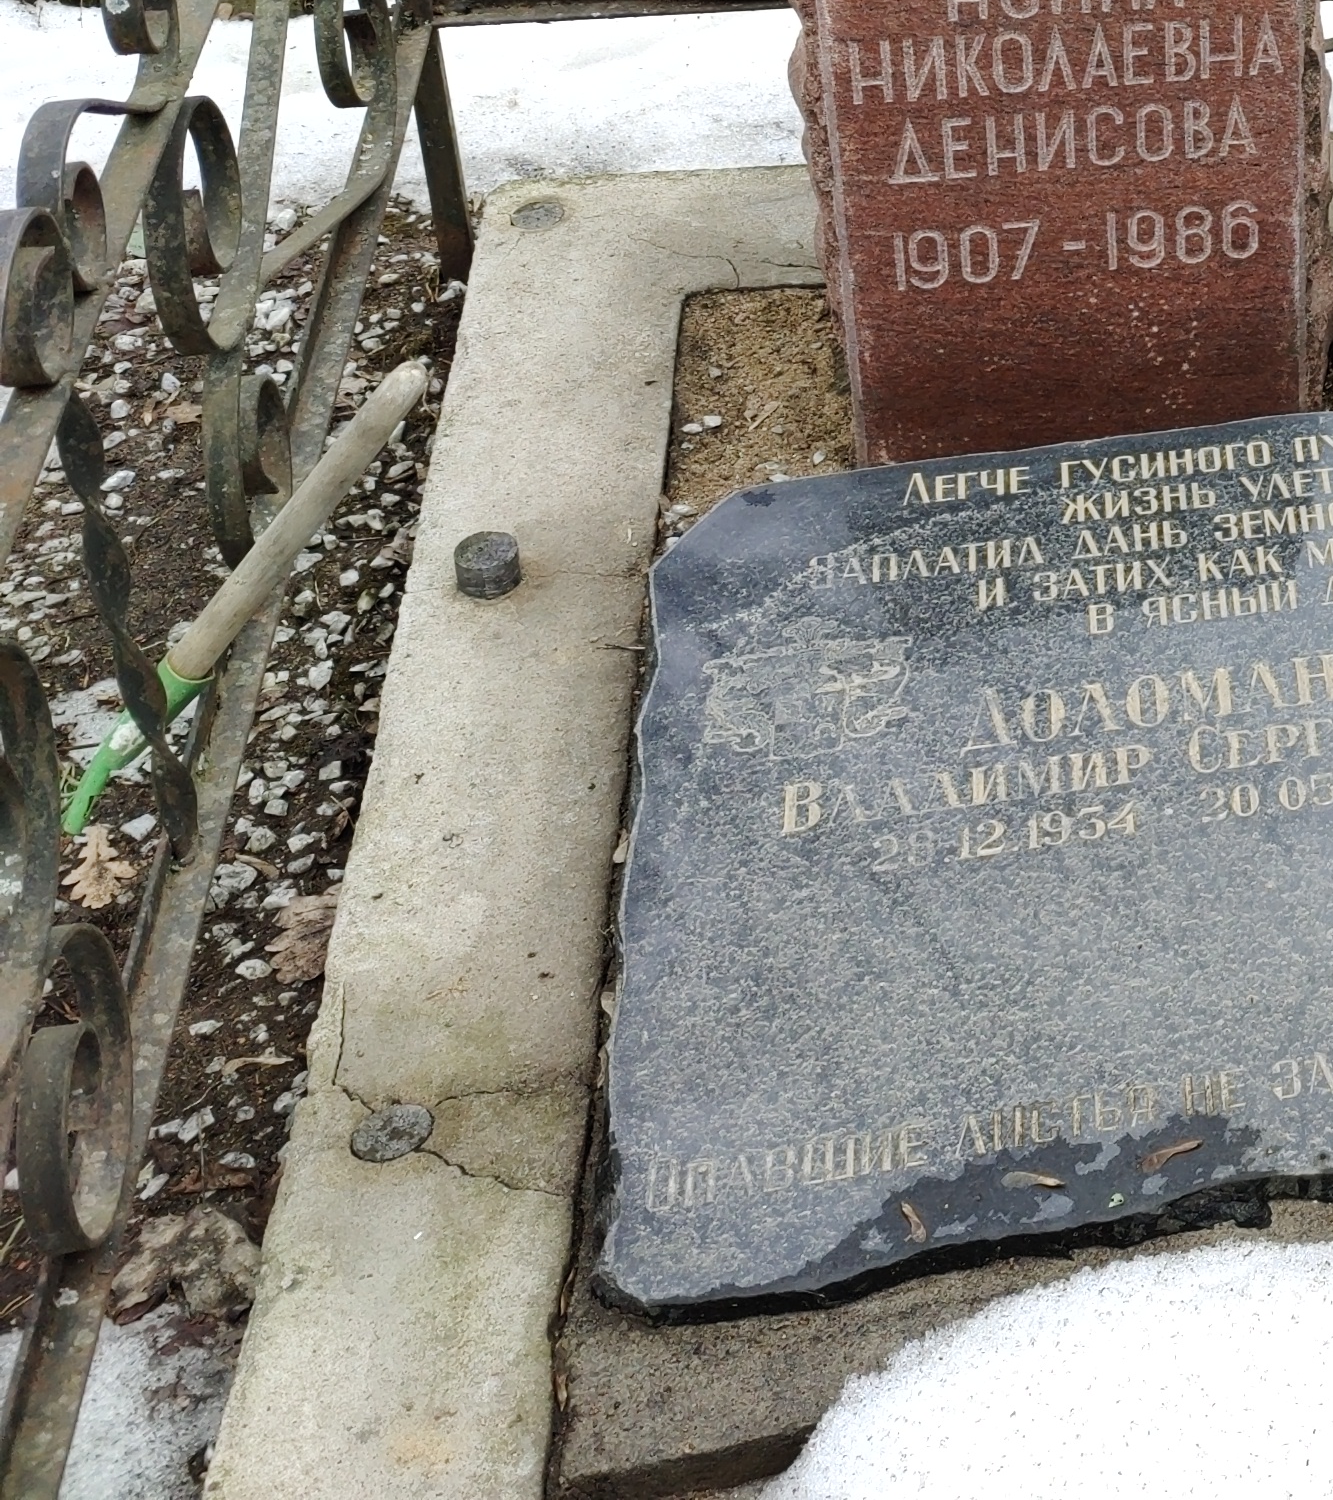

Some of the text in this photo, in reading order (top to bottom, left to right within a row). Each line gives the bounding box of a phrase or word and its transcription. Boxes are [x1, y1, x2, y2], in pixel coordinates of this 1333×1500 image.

[847, 11, 1286, 105] НИКОЛАЕВНА
[887, 95, 1258, 185] ДЕНИСОВА
[902, 466, 1031, 506] ЛЕГЧЕ
[1059, 440, 1272, 489] ГУСИНОГО
[1060, 482, 1217, 525] ЖИЗНЬ
[808, 536, 1045, 590] ЗАПЛАТИЛ
[1070, 519, 1188, 560] ДАНЬ
[977, 576, 1005, 611] И
[1032, 556, 1174, 602] ЗАТИХ
[1199, 545, 1284, 582] КАК
[1087, 602, 1116, 636] В
[1141, 579, 1298, 629] ЯСНЫЙ
[779, 744, 1153, 838] ВЛАДИМИР
[648, 1122, 930, 1214] ОПАВШИЕ
[955, 1083, 1157, 1158] ЛИСТЬЯ
[1181, 1066, 1249, 1118] НЕ
